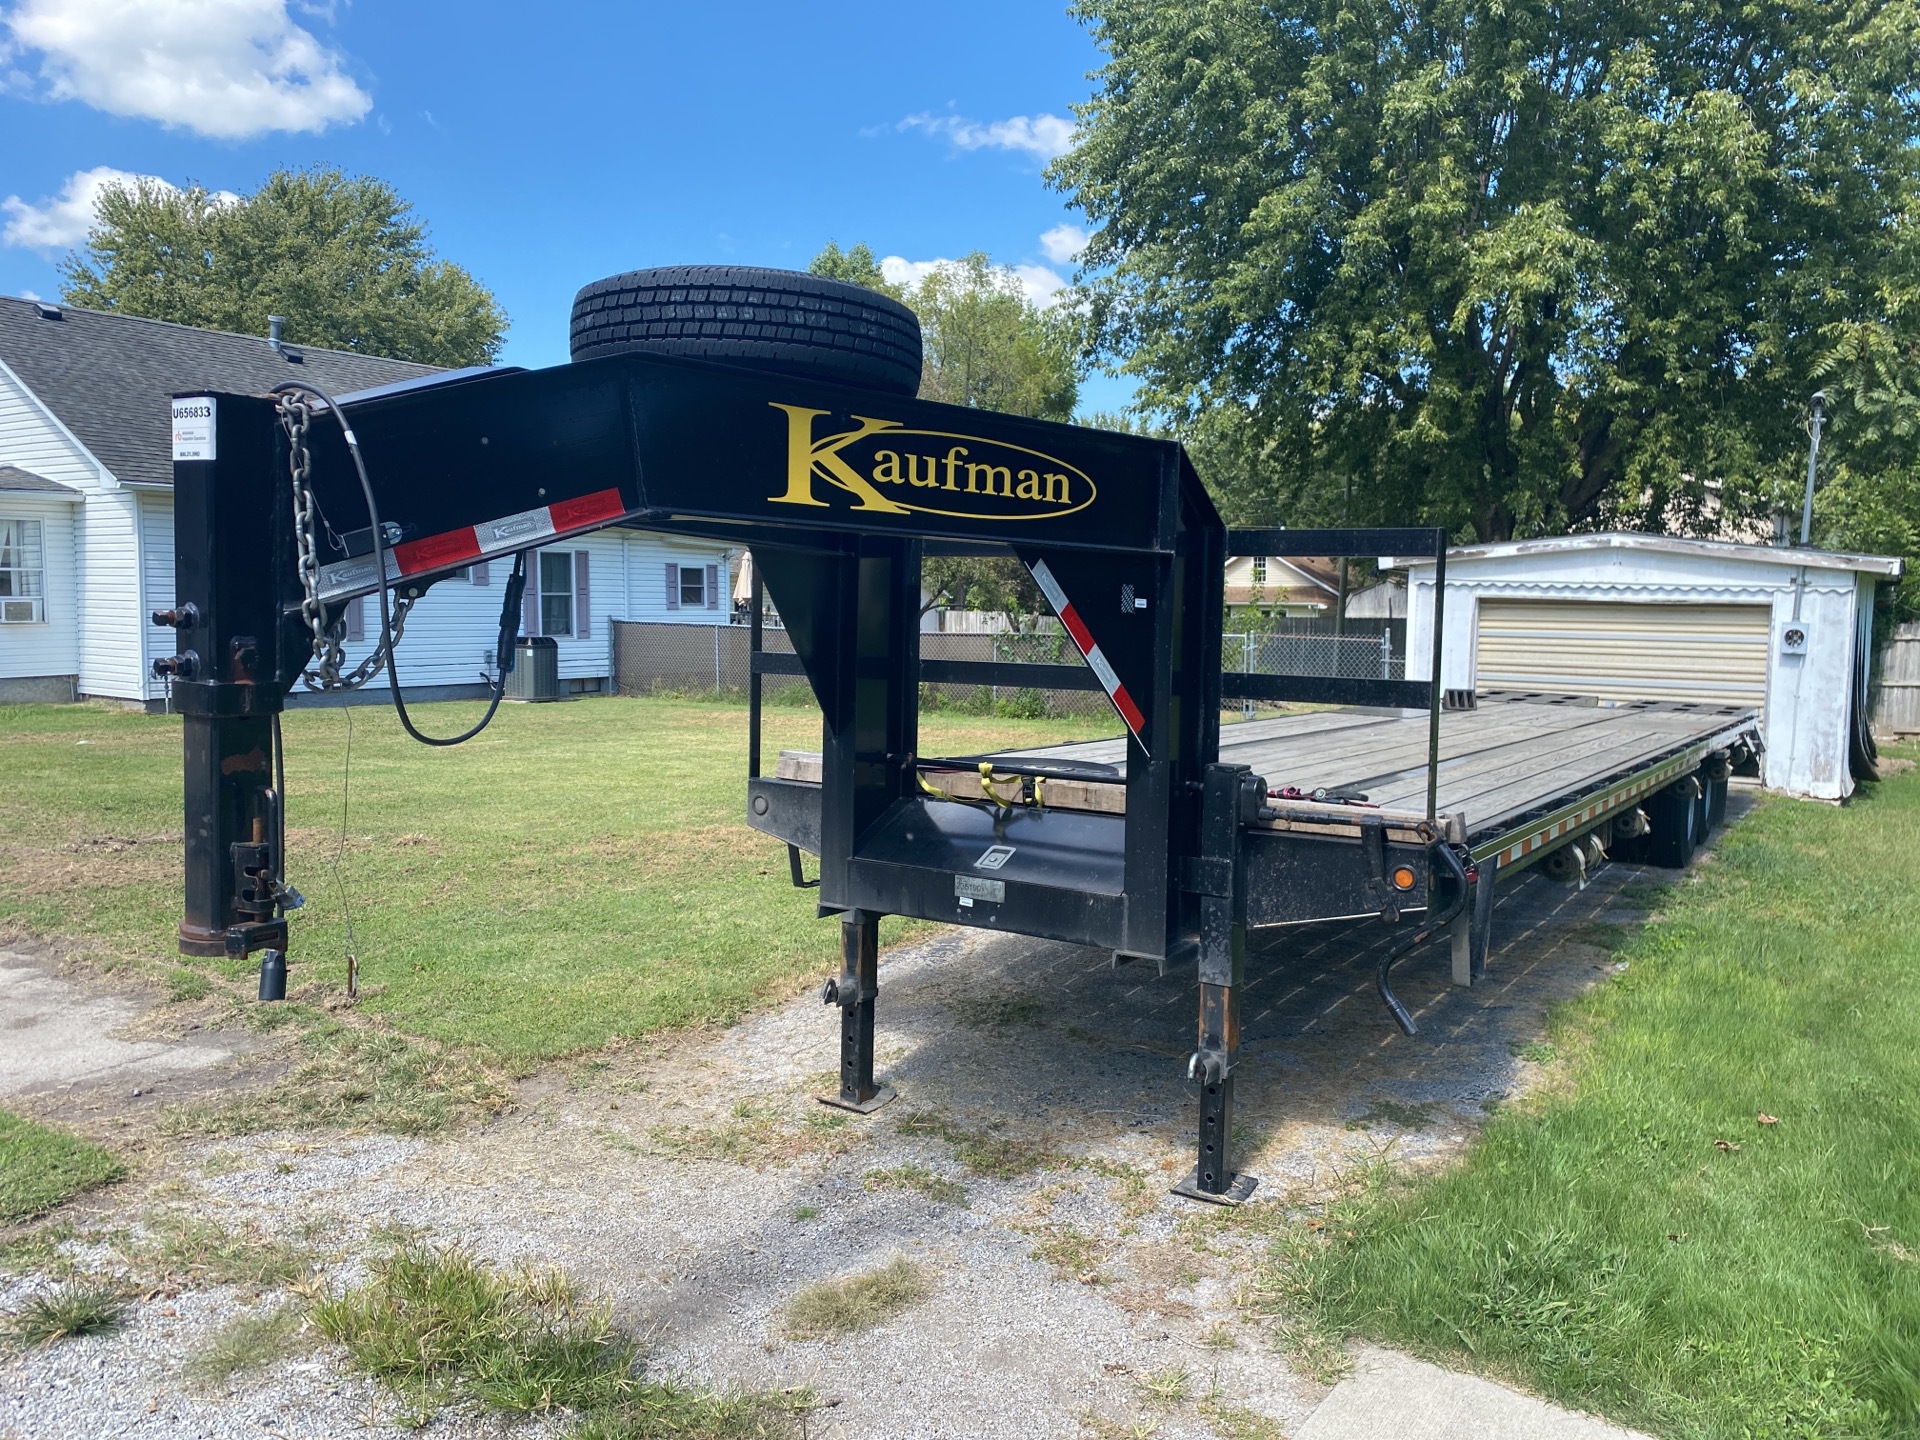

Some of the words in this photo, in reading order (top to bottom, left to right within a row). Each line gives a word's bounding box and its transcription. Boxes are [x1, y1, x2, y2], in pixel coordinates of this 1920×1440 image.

[173, 406, 211, 419] U656833
[767, 401, 1072, 515] Kaufman
[493, 521, 532, 539] Kaufman
[328, 566, 374, 585] Kaufman
